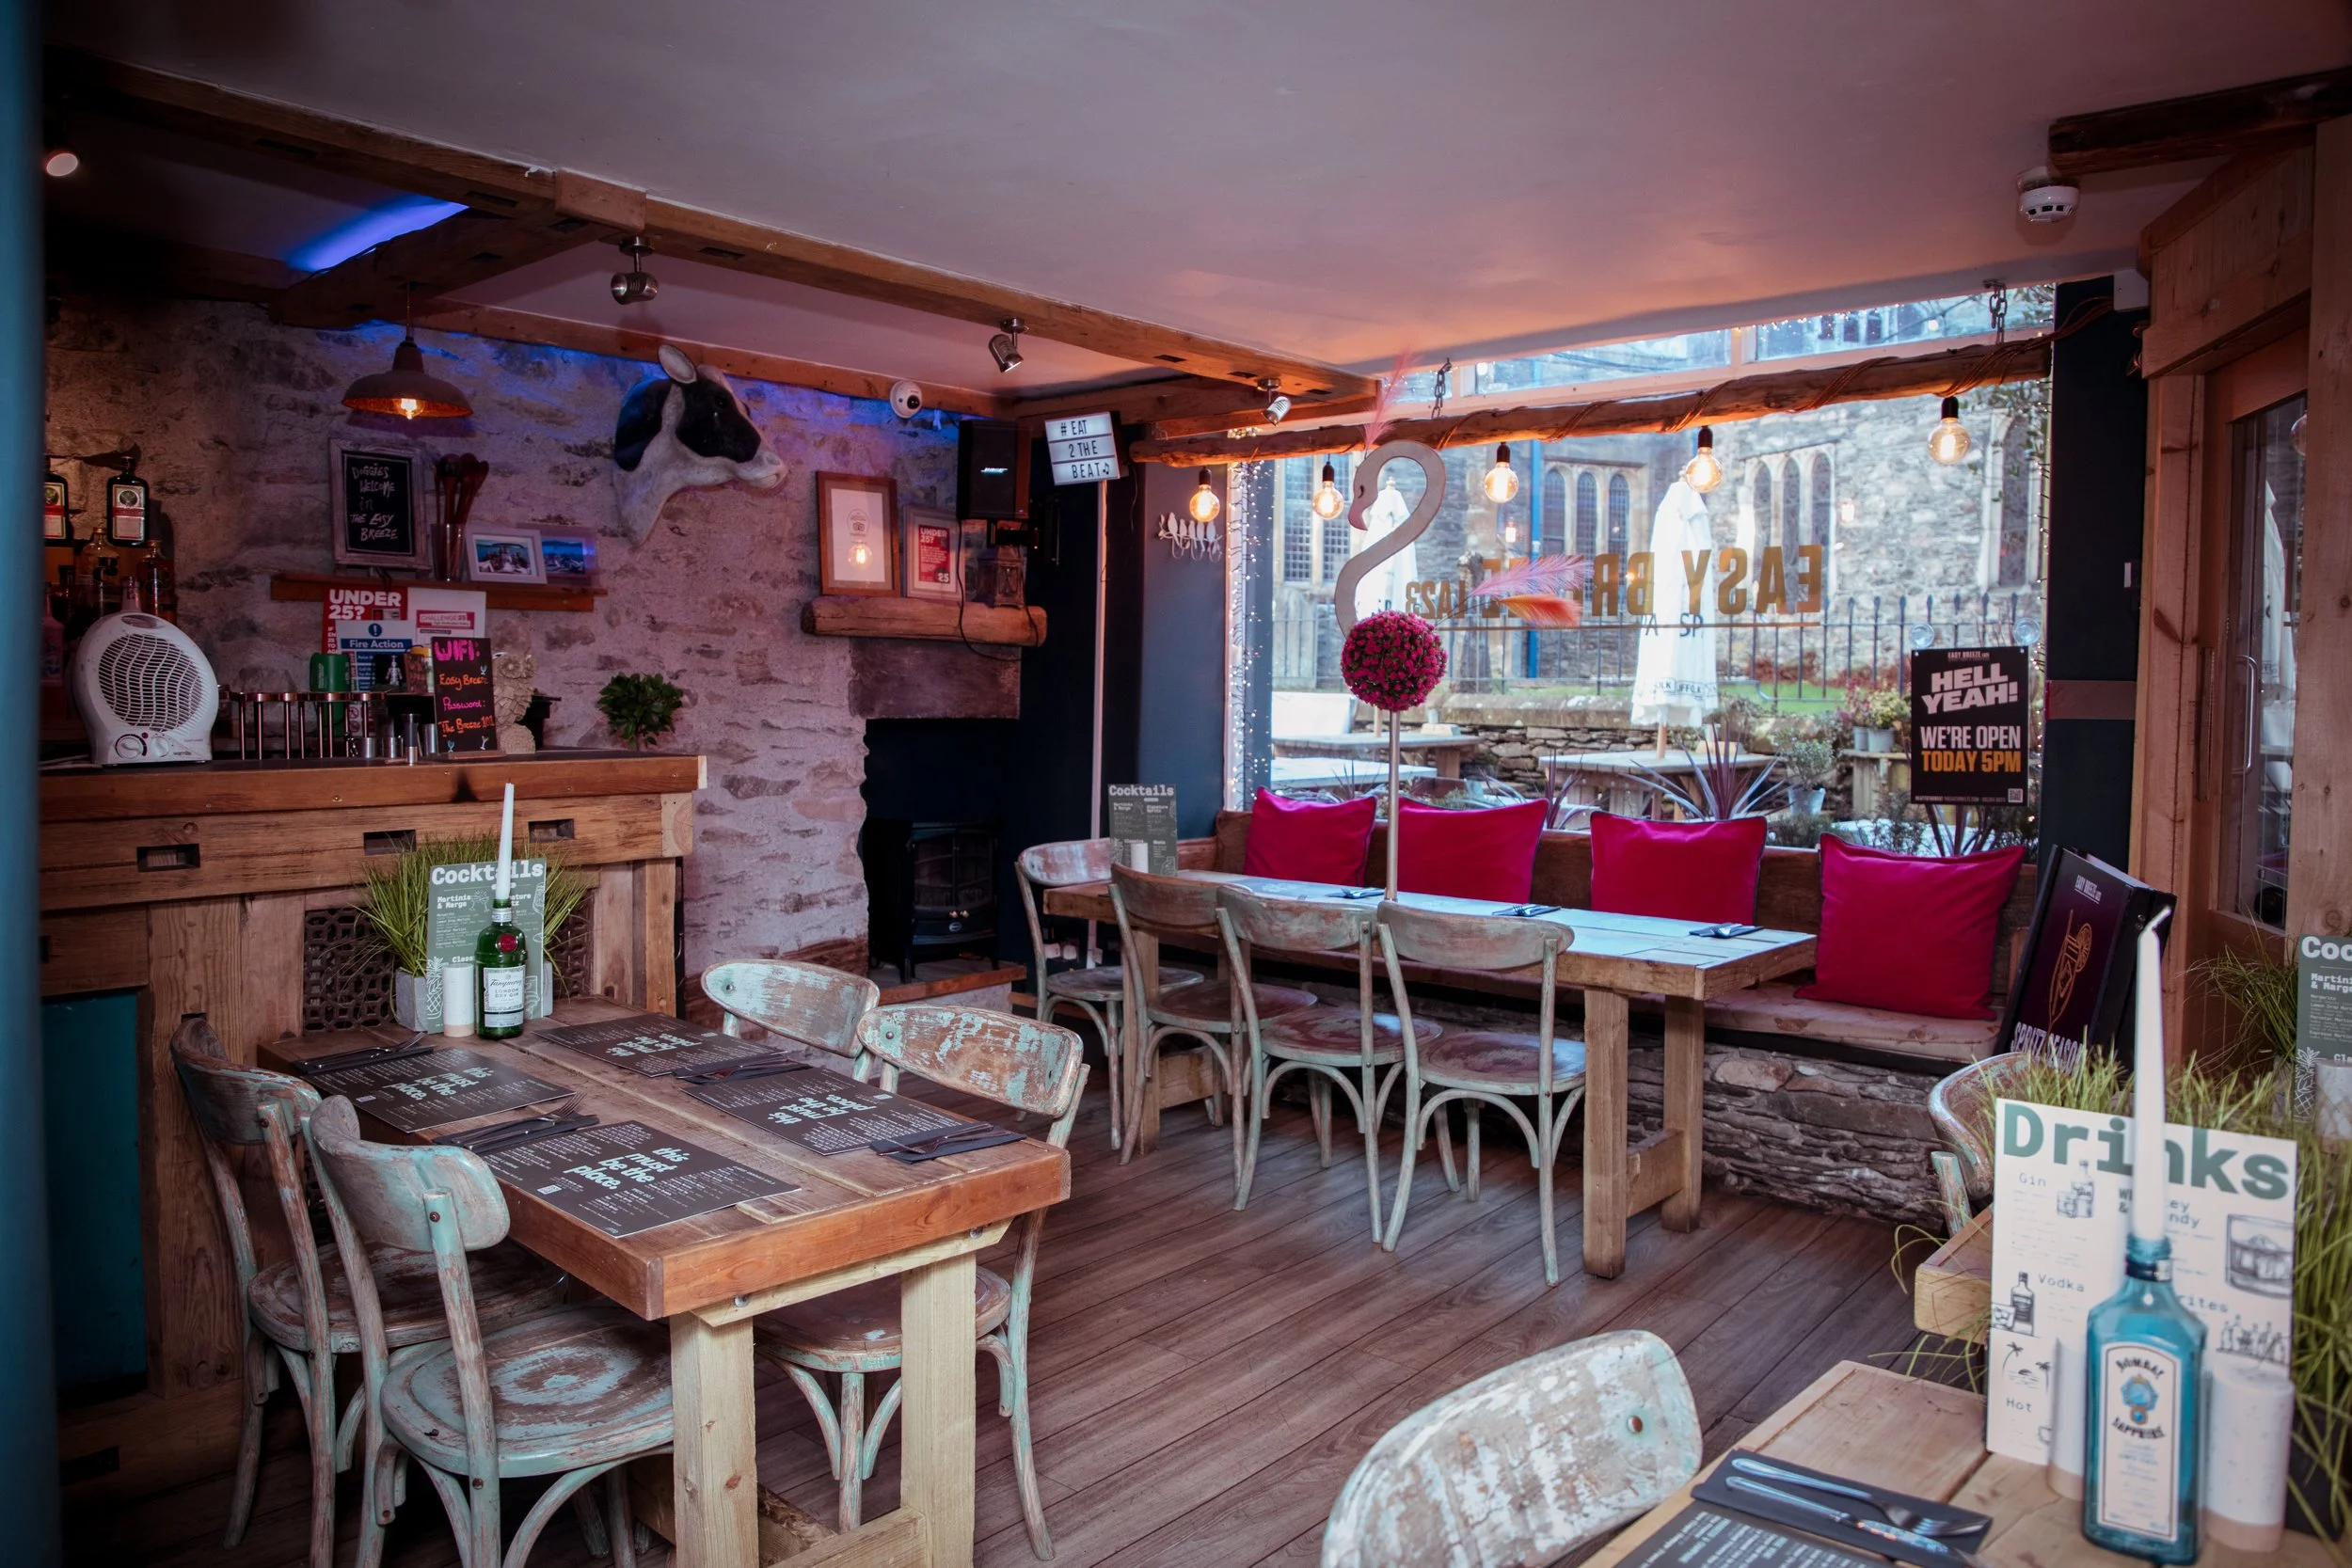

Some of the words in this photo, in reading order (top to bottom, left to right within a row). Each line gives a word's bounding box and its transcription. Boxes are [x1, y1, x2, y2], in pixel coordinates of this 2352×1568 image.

[1071, 420, 1087, 435] EAT
[1068, 443, 1075, 458] 2
[1077, 440, 1097, 457] THE
[1072, 462, 1100, 478] BEAT
[360, 496, 373, 511] in
[361, 527, 398, 542] BREEZE
[921, 528, 947, 538] UNDER
[329, 589, 401, 607] UNDER
[328, 605, 366, 620] 25?
[349, 639, 375, 649] Fire
[376, 640, 405, 649] Action
[1931, 663, 2009, 694] HELL
[1921, 681, 2018, 714] YEAH!
[1920, 726, 1971, 749] WE'RE
[1976, 726, 2021, 749] OPEN
[1921, 750, 1978, 772] TODAY
[1981, 750, 2022, 772] 5PM
[1108, 784, 1175, 796] Cocktails
[431, 860, 544, 885] Cocktils
[437, 894, 471, 903] Martinis
[2010, 1022, 2048, 1061] SPRITZ
[439, 1072, 479, 1087] must
[625, 1153, 678, 1173] must
[652, 1147, 690, 1163] this
[598, 1156, 628, 1171] be
[621, 1167, 655, 1183] the
[2018, 1172, 2047, 1187] Gin
[2038, 1274, 2085, 1292] Vodka
[2005, 1397, 2033, 1413] Hot
